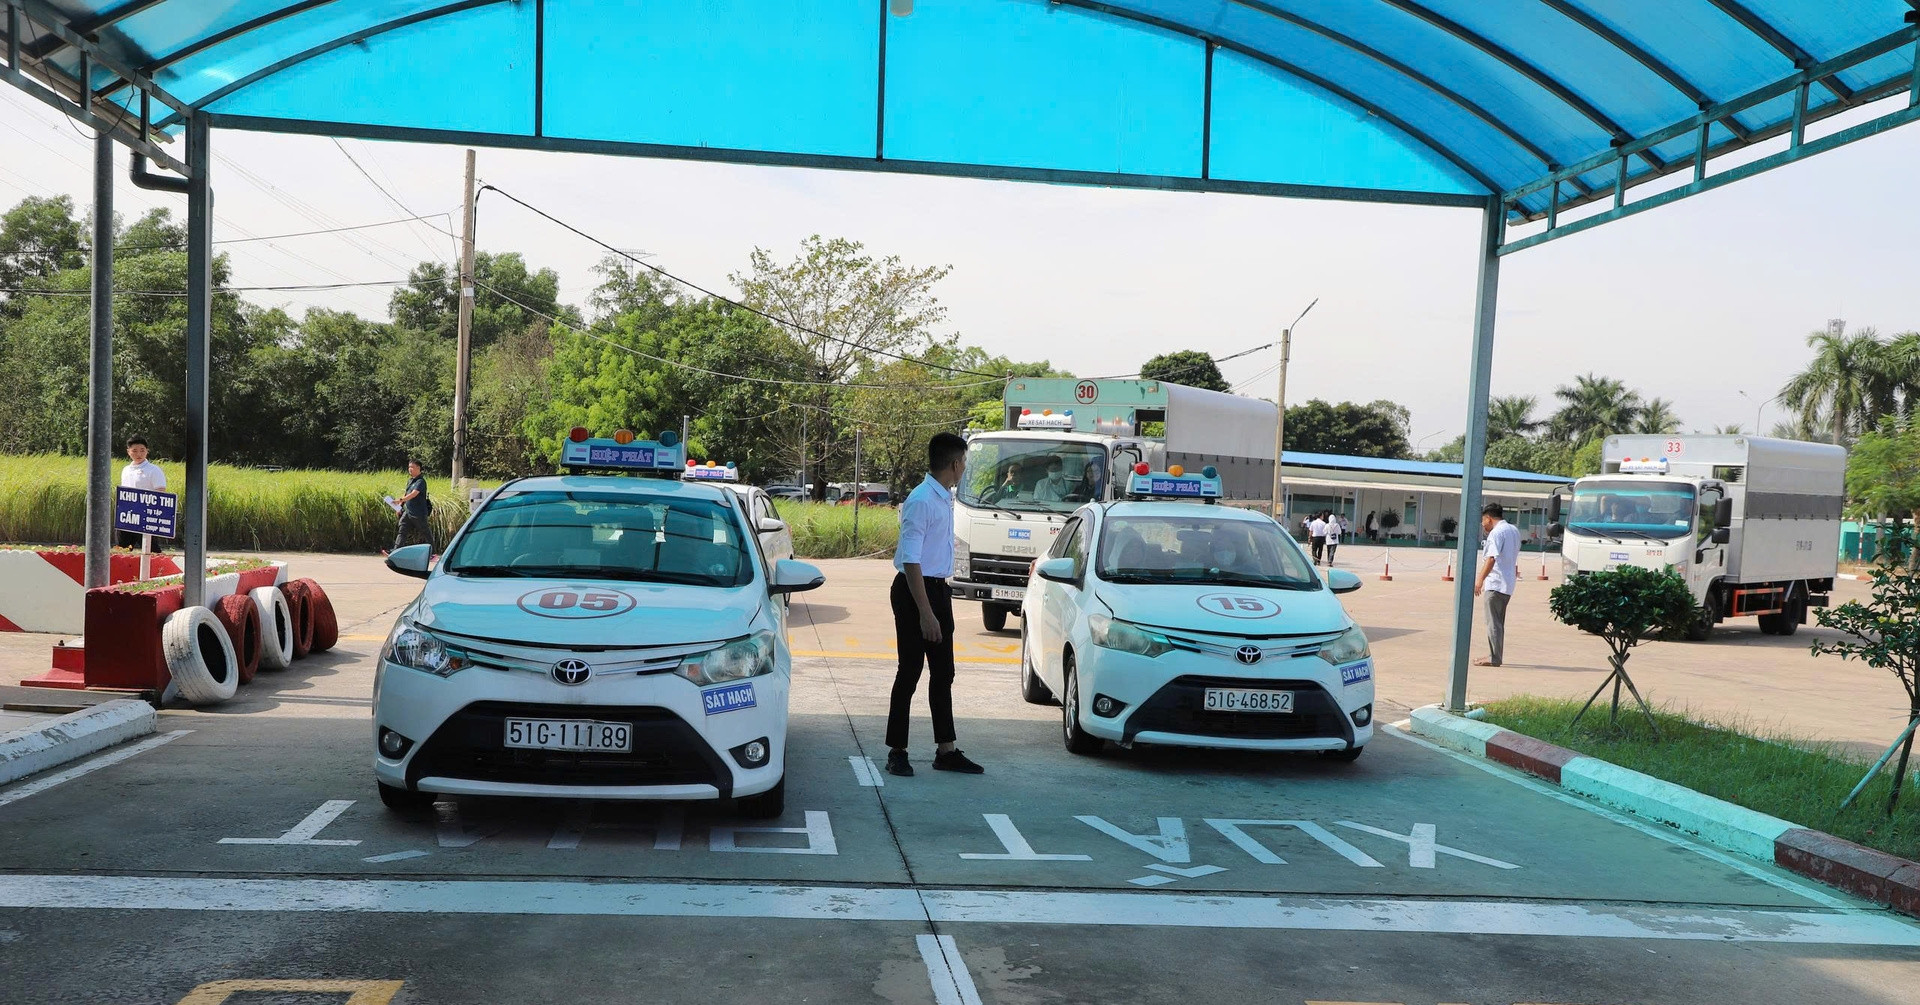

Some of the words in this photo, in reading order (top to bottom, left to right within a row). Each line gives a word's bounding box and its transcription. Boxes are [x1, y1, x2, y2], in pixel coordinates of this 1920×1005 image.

[1078, 385, 1095, 399] 30
[1667, 442, 1680, 453] 33
[591, 448, 620, 463] HIỆP
[621, 449, 653, 463] PHÁT
[1153, 481, 1175, 493] HIỆP
[1176, 482, 1199, 493] PHÁT
[120, 490, 138, 502] KHU
[139, 492, 157, 506] VỰC
[160, 496, 174, 507] THI
[120, 509, 140, 525] CẤM
[1002, 544, 1036, 554] ISUZU
[538, 591, 619, 610] 05
[1211, 597, 1264, 611] 15
[705, 691, 726, 709] SÁT
[726, 688, 754, 707] HẠCH
[1207, 691, 1290, 710] 51G-468.52
[509, 721, 627, 748] 51G-111.89
